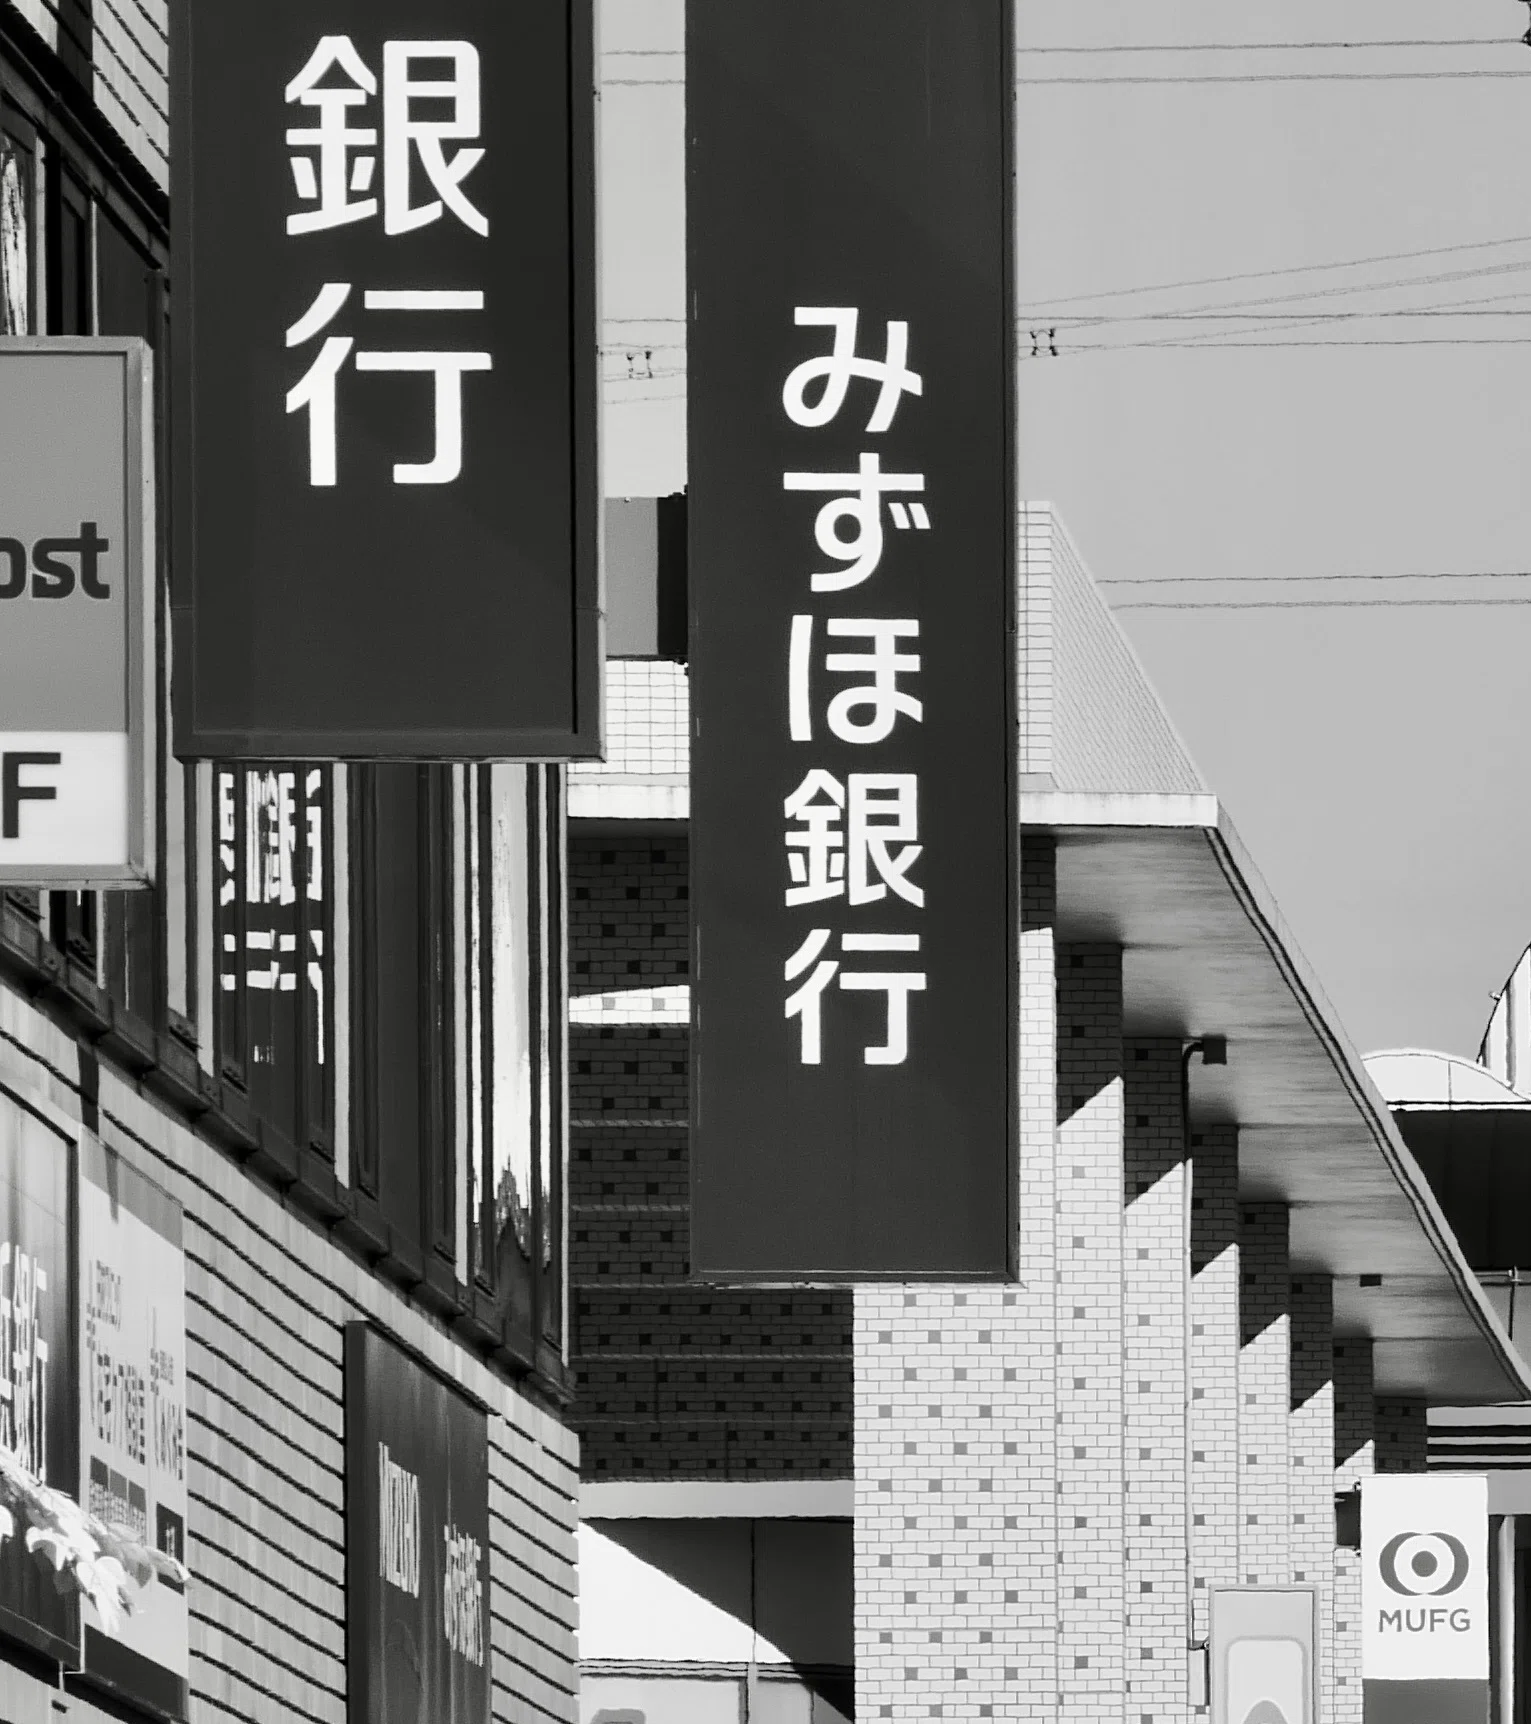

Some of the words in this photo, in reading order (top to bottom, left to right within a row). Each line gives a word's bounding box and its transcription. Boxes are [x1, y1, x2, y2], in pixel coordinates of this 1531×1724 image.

[284, 35, 493, 487] 銀行
[782, 305, 932, 1066] みずほ銀行
[1378, 1608, 1472, 1633] MUFG
